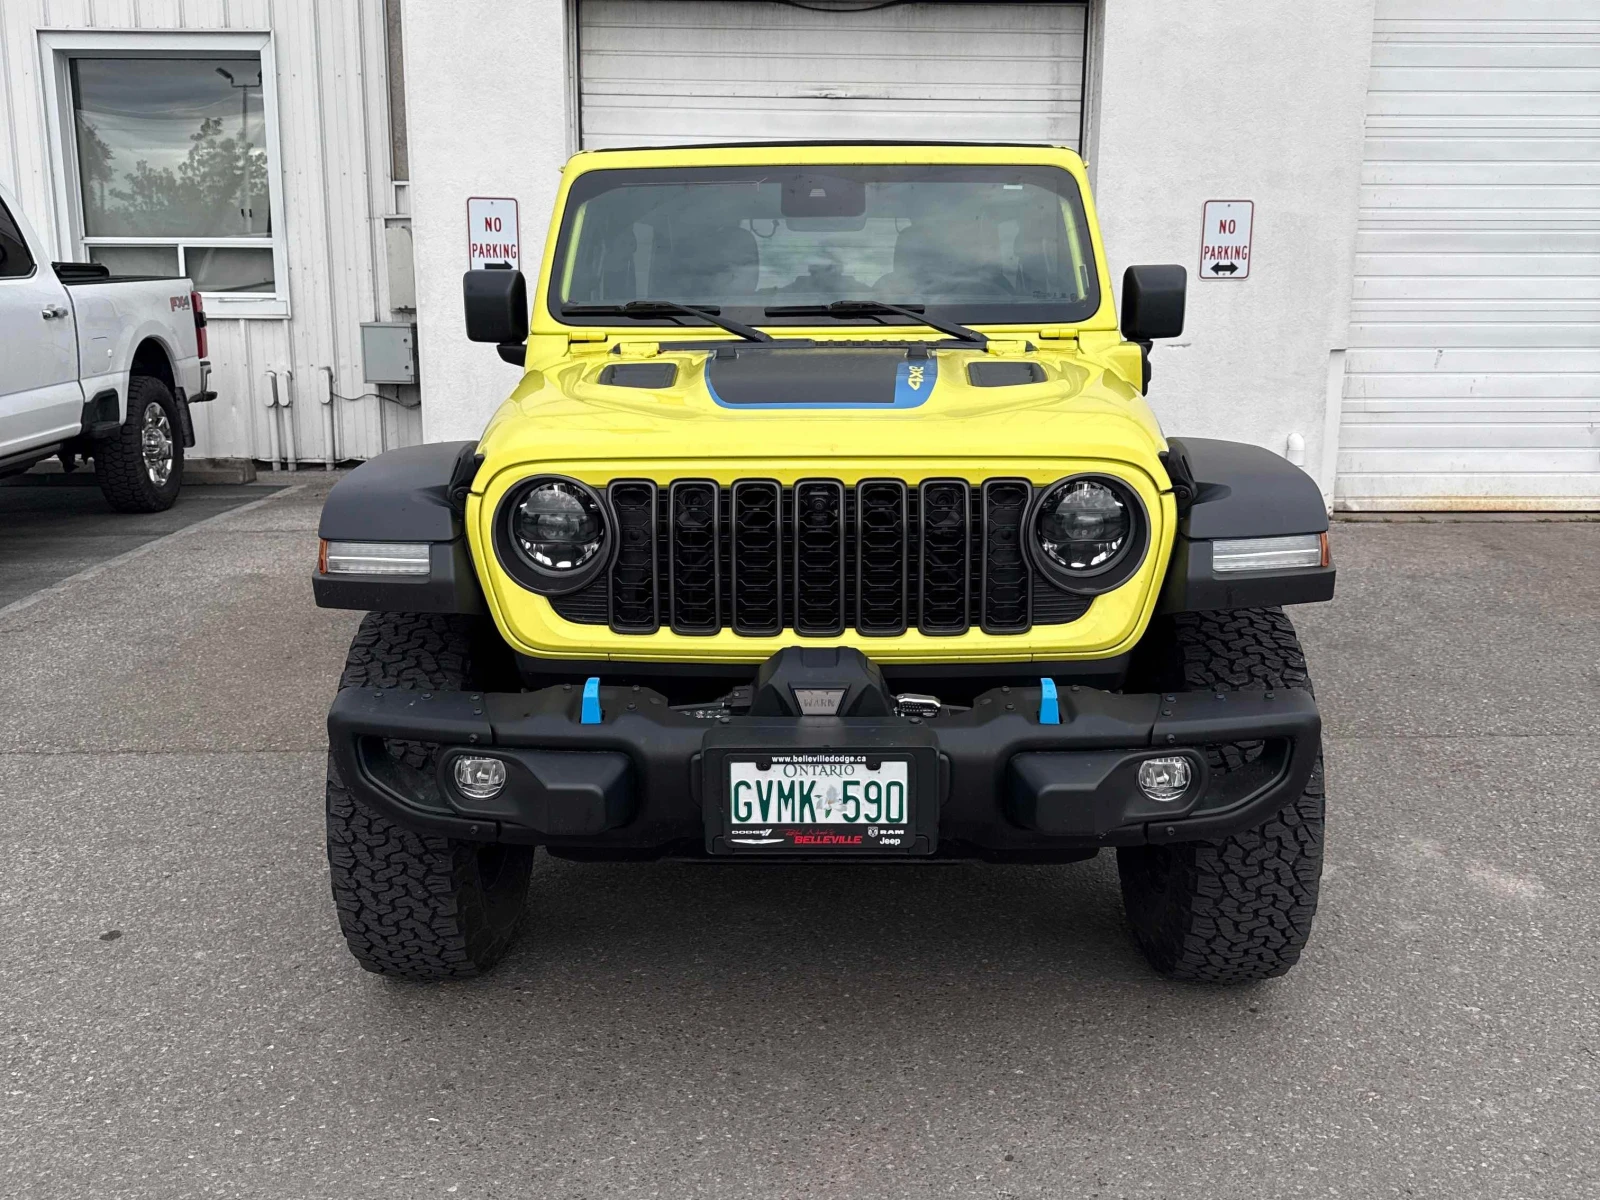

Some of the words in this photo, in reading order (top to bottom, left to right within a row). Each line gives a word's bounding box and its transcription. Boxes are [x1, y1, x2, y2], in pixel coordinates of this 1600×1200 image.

[484, 217, 502, 232] NO
[1219, 219, 1236, 235] NO
[472, 243, 517, 259] PARKING
[1203, 245, 1248, 260] PARKING
[803, 698, 835, 707] WARN
[771, 755, 867, 764] www.bellevilledodge.ca
[783, 763, 855, 778] ONTARIO
[733, 780, 817, 823] GVMK
[842, 780, 904, 823] 590
[794, 835, 863, 844] BELLEVILLE
[879, 836, 901, 846] Jeep
